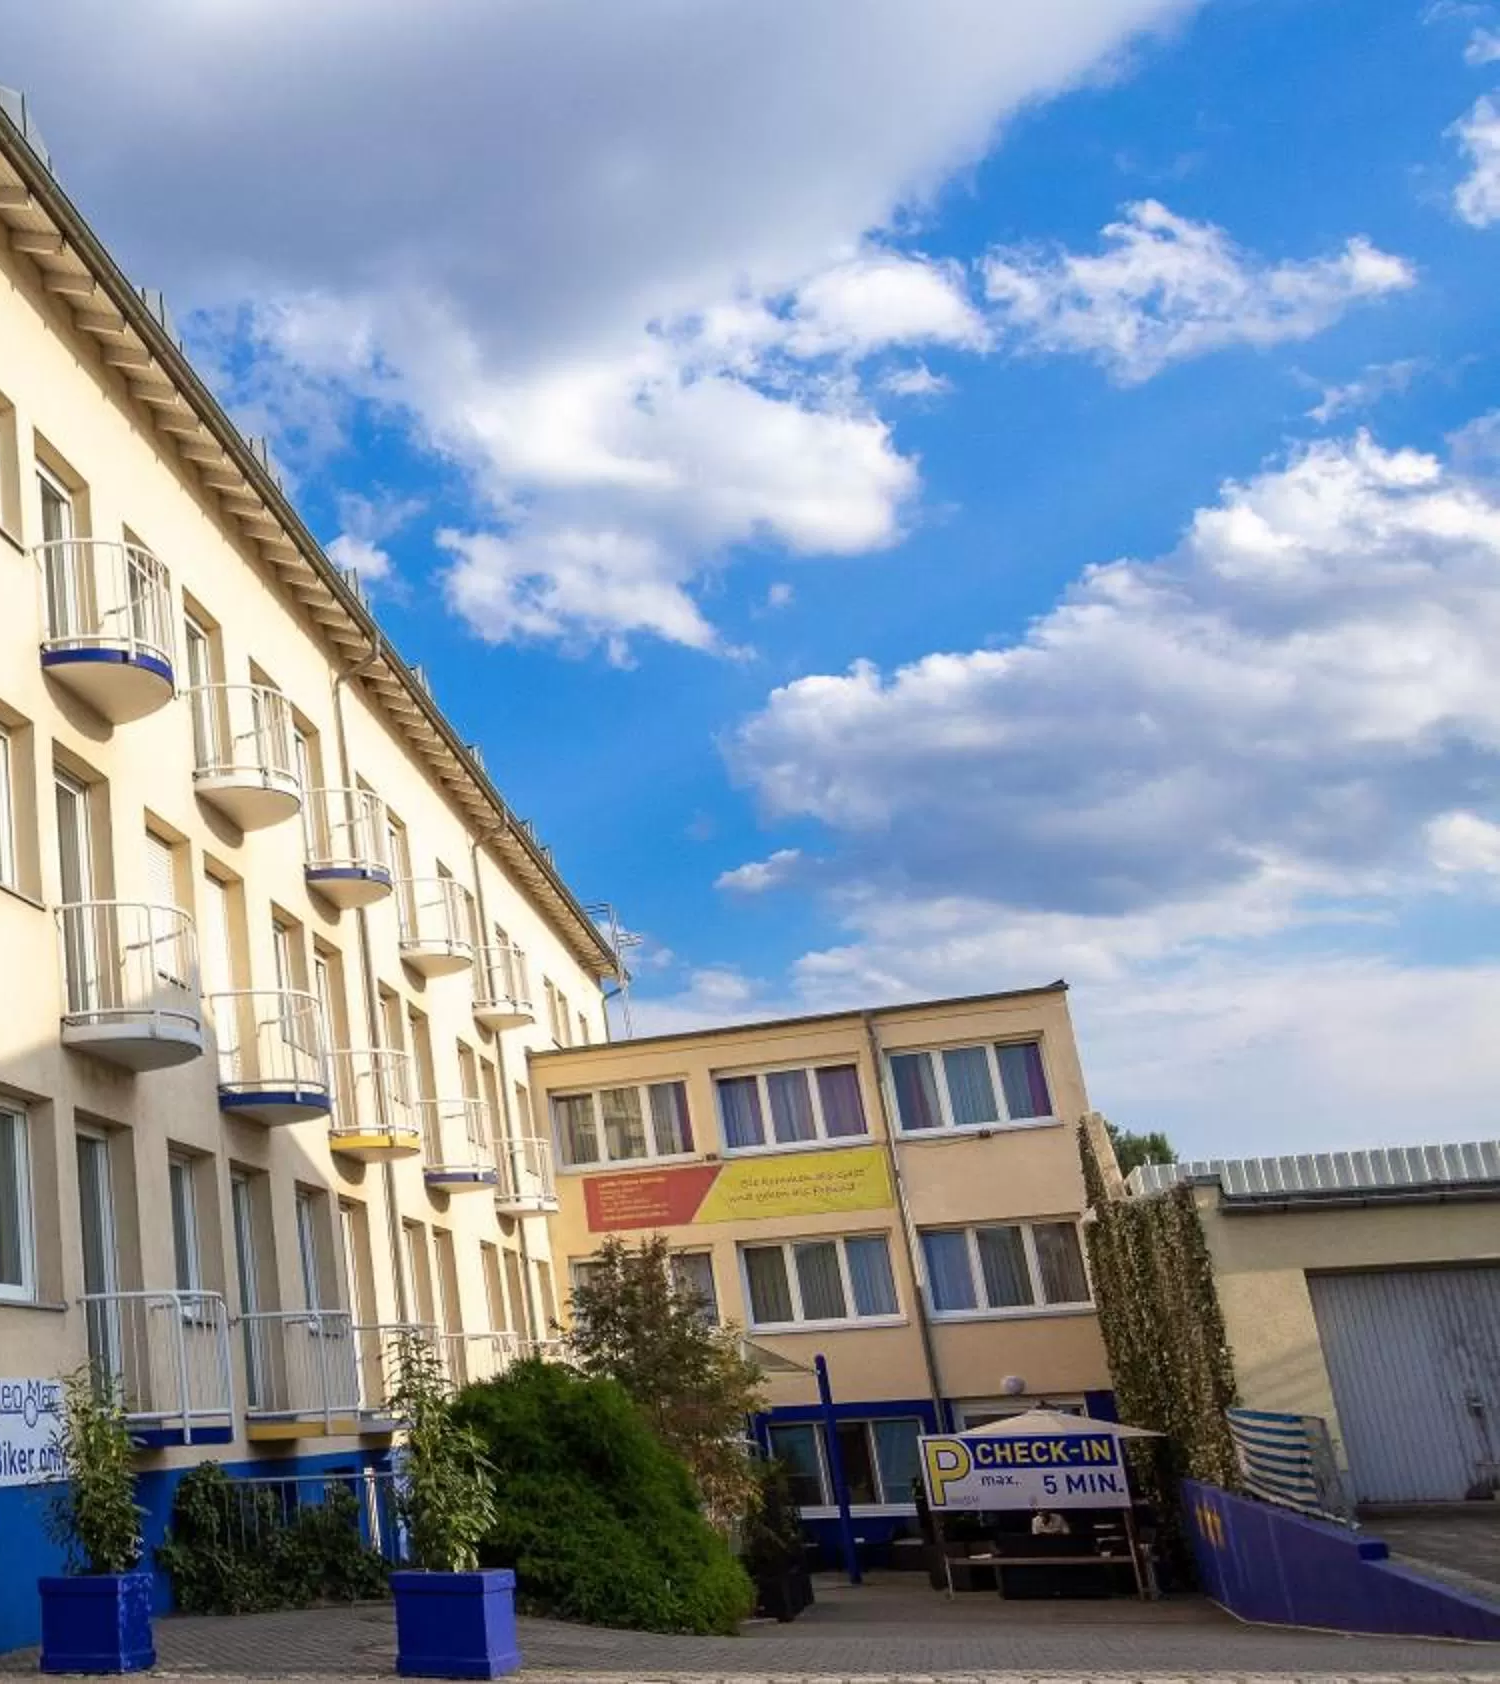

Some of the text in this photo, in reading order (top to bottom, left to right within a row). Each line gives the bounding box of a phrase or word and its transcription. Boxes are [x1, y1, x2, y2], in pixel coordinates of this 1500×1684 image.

[975, 1439, 1112, 1465] CHECK-IN
[1043, 1475, 1057, 1495] 5
[1066, 1473, 1125, 1495] MIN.
